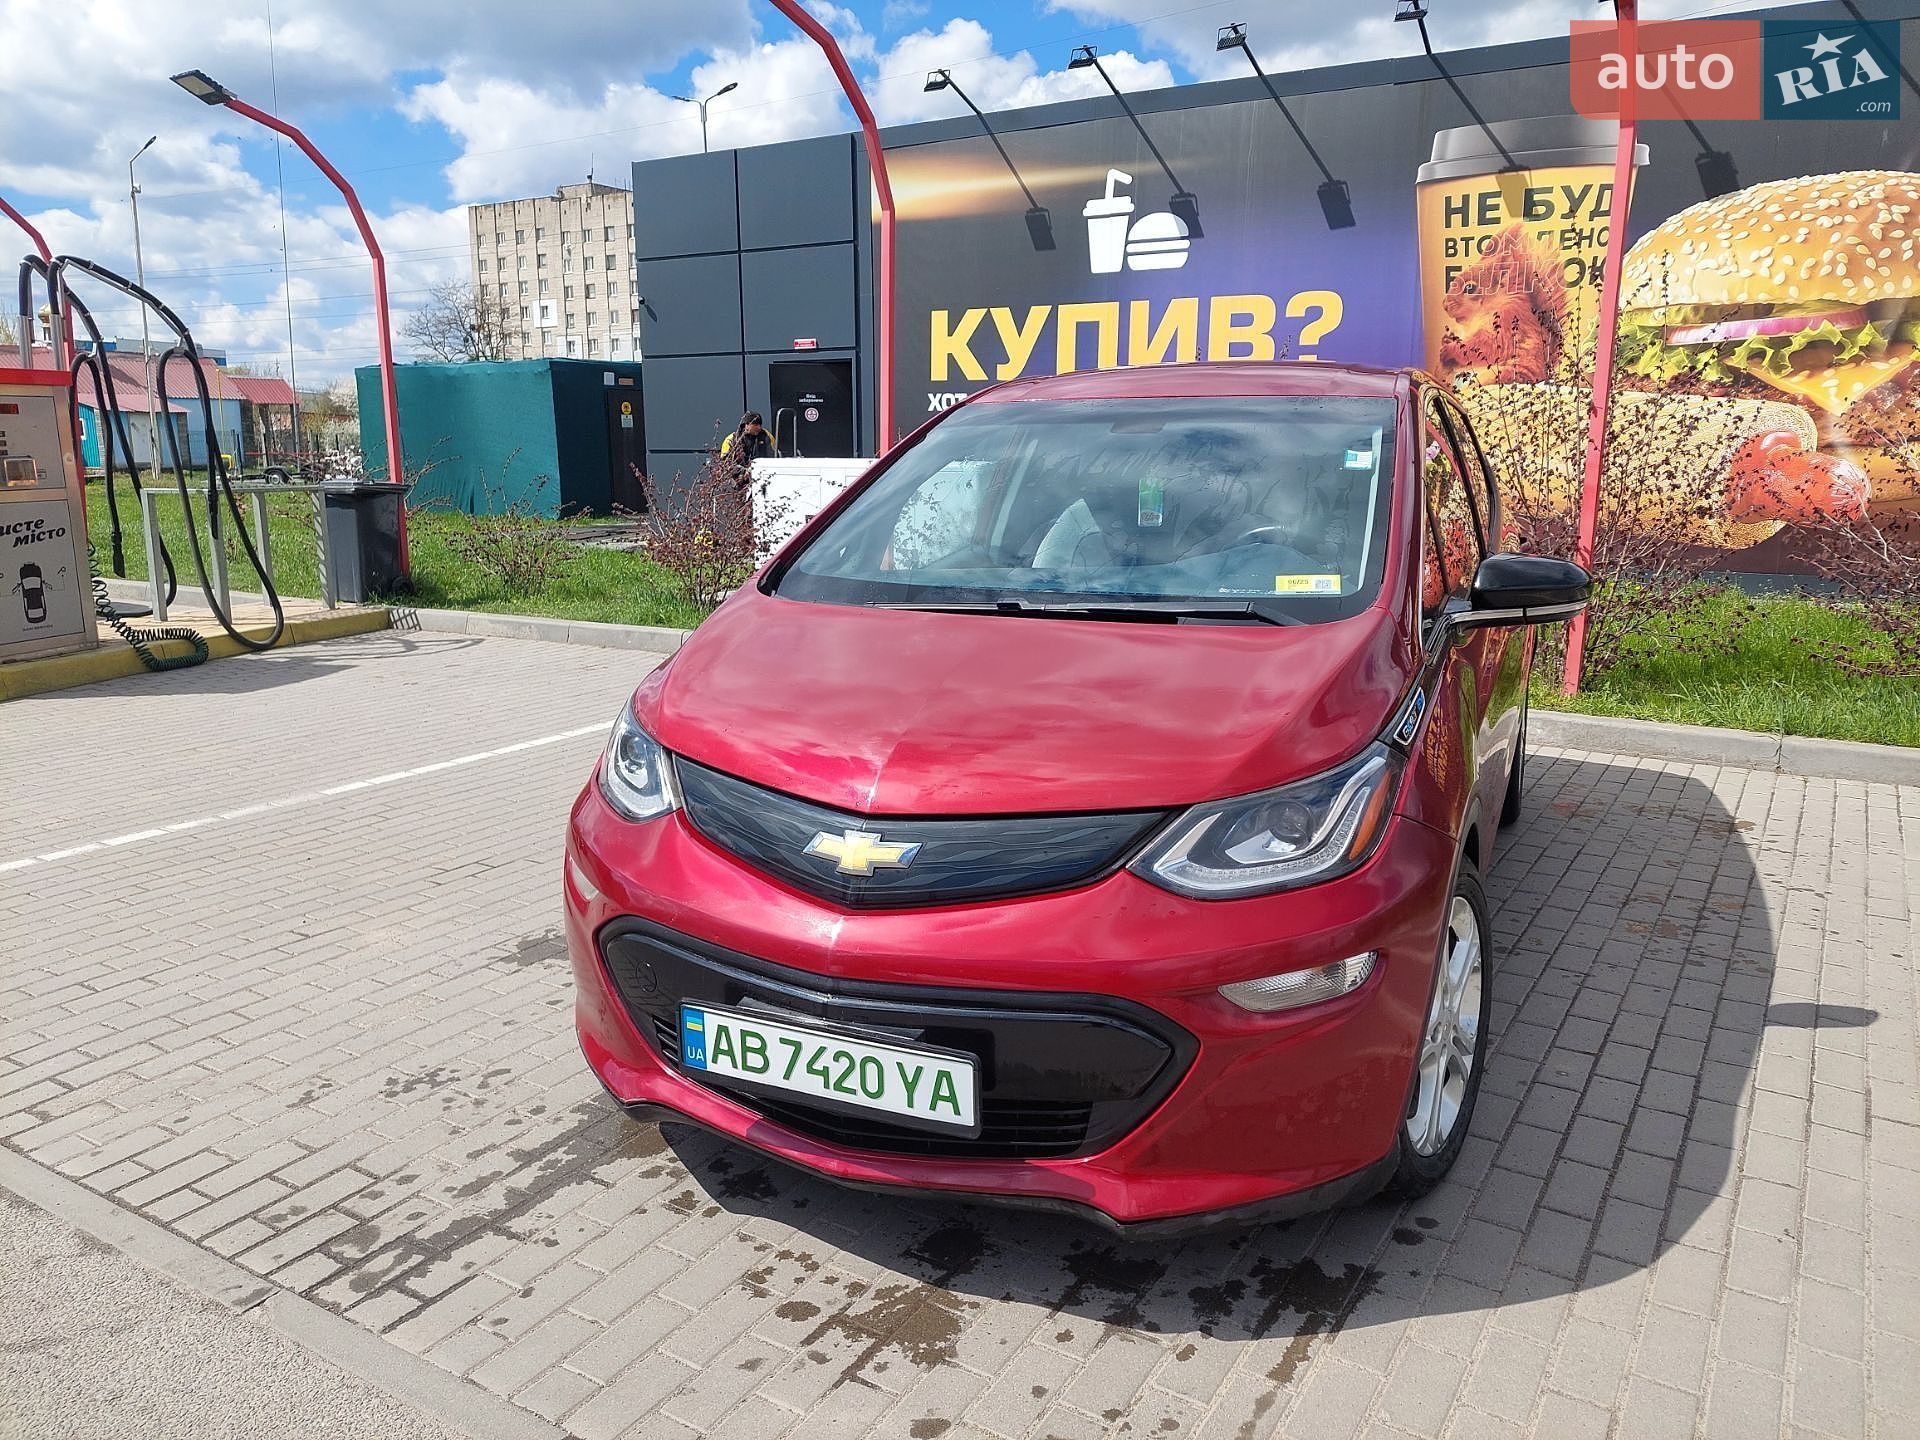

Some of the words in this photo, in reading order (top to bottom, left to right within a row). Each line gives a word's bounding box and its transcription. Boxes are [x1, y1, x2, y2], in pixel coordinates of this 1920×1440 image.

[1444, 190, 1503, 229] НЕ
[930, 289, 1344, 382] КУПИВ?
[13, 527, 66, 548] місто
[687, 1047, 705, 1062] UA
[711, 1023, 770, 1075] AB
[778, 1036, 885, 1100] 7420
[895, 1061, 962, 1117] YA
